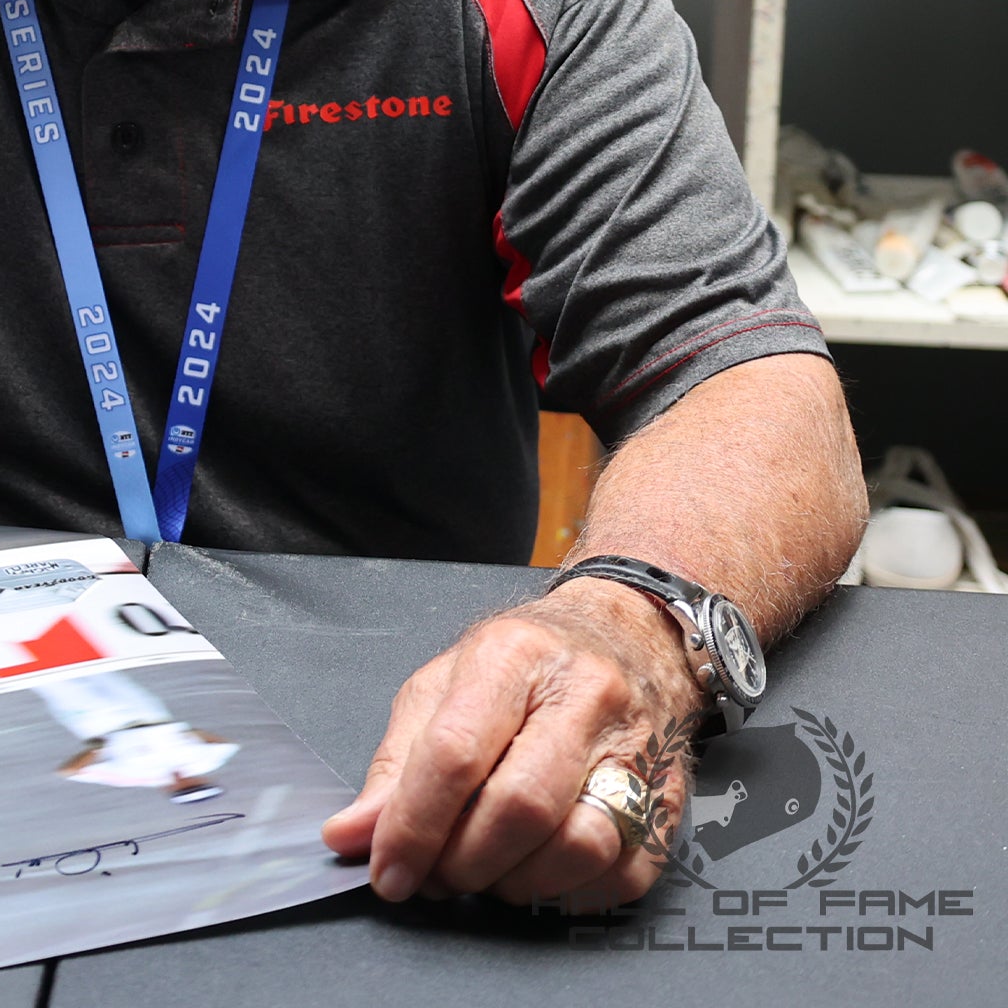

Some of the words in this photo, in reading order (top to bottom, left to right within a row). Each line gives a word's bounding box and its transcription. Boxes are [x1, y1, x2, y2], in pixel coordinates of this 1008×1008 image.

[233, 27, 278, 133] 2024
[262, 94, 454, 132] Firestone
[77, 304, 126, 412] 2024
[177, 301, 222, 407] 2024
